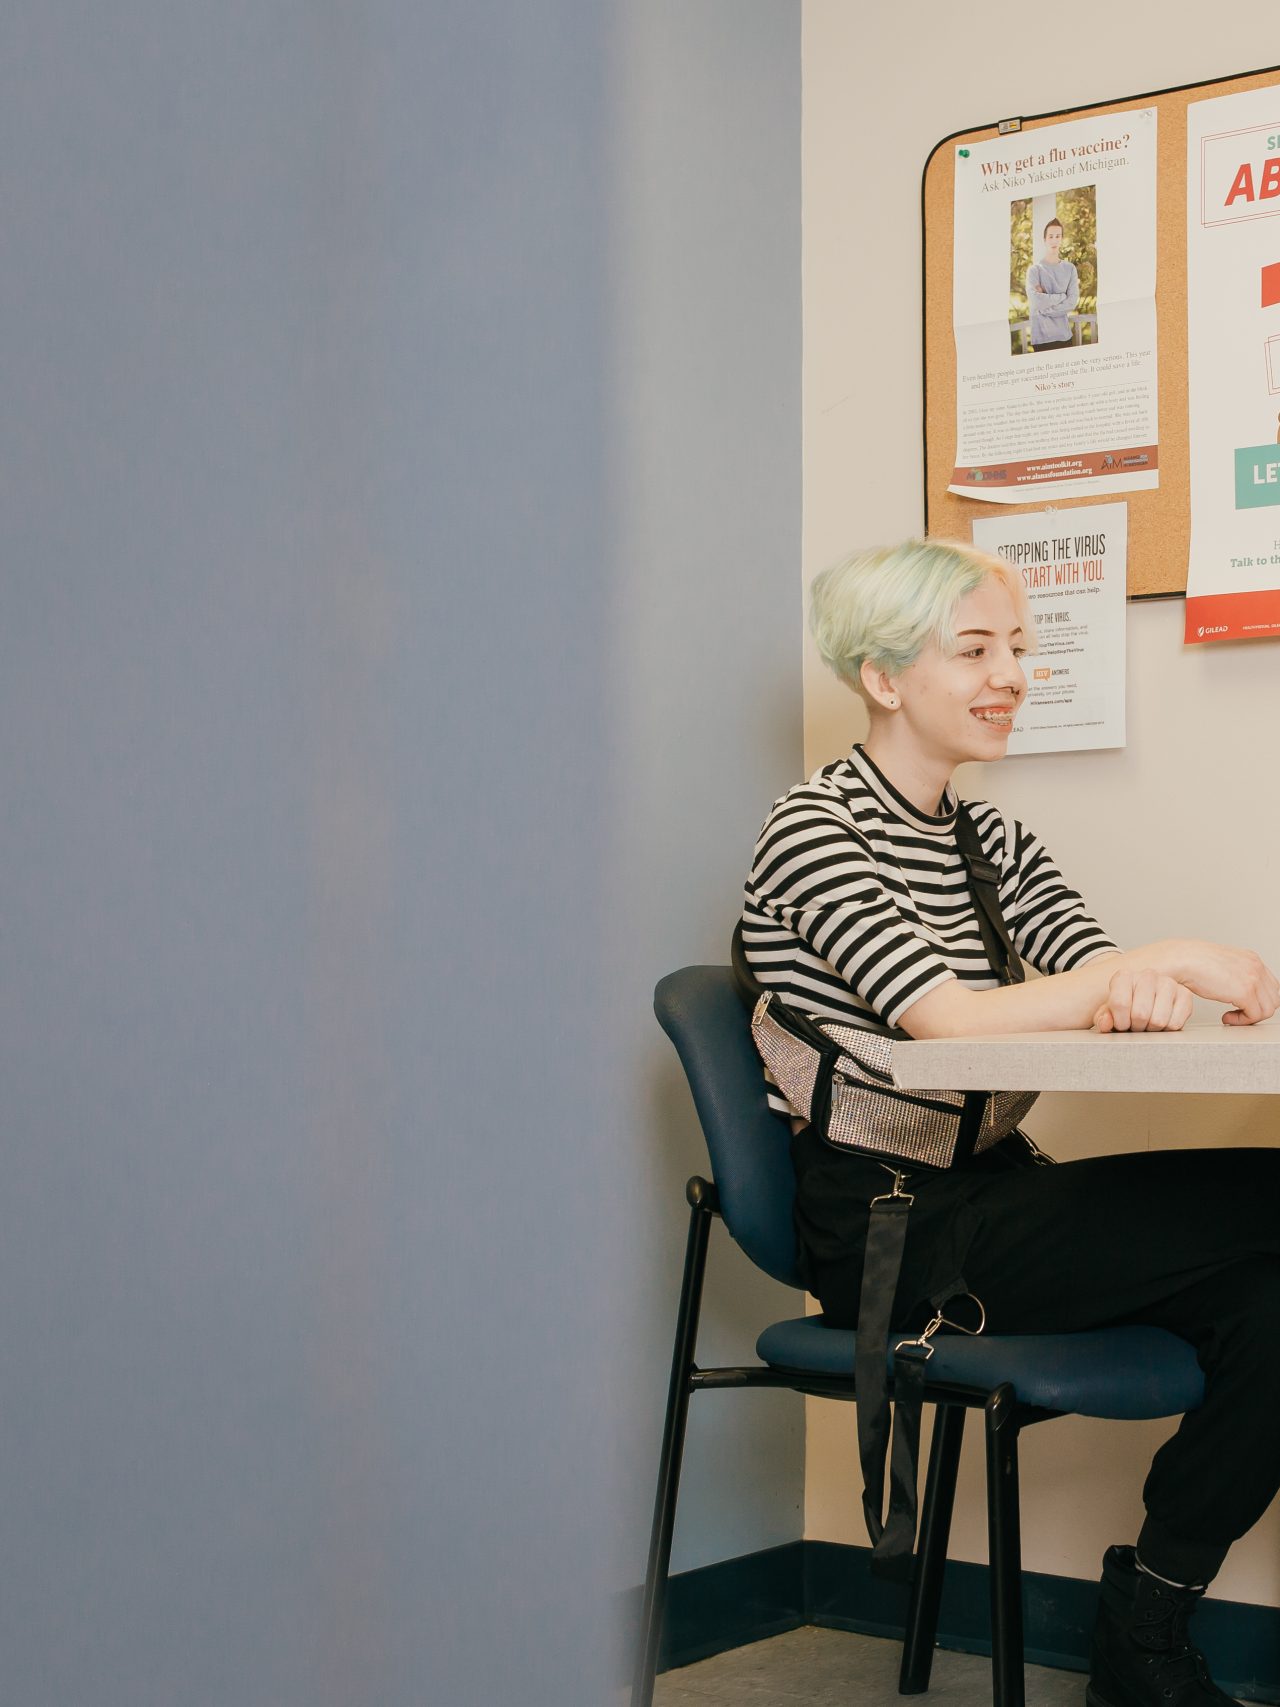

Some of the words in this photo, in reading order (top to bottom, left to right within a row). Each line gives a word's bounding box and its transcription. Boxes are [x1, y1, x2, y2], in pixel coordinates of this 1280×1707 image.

[981, 161, 1009, 177] Why
[1015, 156, 1034, 174] get
[1038, 154, 1046, 165] a
[1050, 148, 1067, 163] flu
[1071, 134, 1131, 158] vaccine?
[981, 180, 1001, 193] Ask
[1002, 176, 1026, 189] Niko
[1027, 167, 1064, 185] Yaksich
[1066, 164, 1077, 176] of
[1079, 156, 1129, 174] Michigan.
[1035, 382, 1057, 392] Niko's
[1058, 381, 1075, 390] story
[1052, 537, 1072, 561] THE
[1074, 533, 1106, 557] VIRUS
[1230, 556, 1254, 568] Talk
[1256, 556, 1268, 566] to
[1021, 565, 1052, 589] START
[1055, 561, 1079, 585] WITH
[1082, 559, 1105, 582] YOU.
[1037, 590, 1064, 599] resources
[1075, 588, 1086, 596] can
[1044, 612, 1054, 624] THE
[1054, 611, 1072, 623] VIRUS.
[1205, 626, 1229, 634] GILEAD
